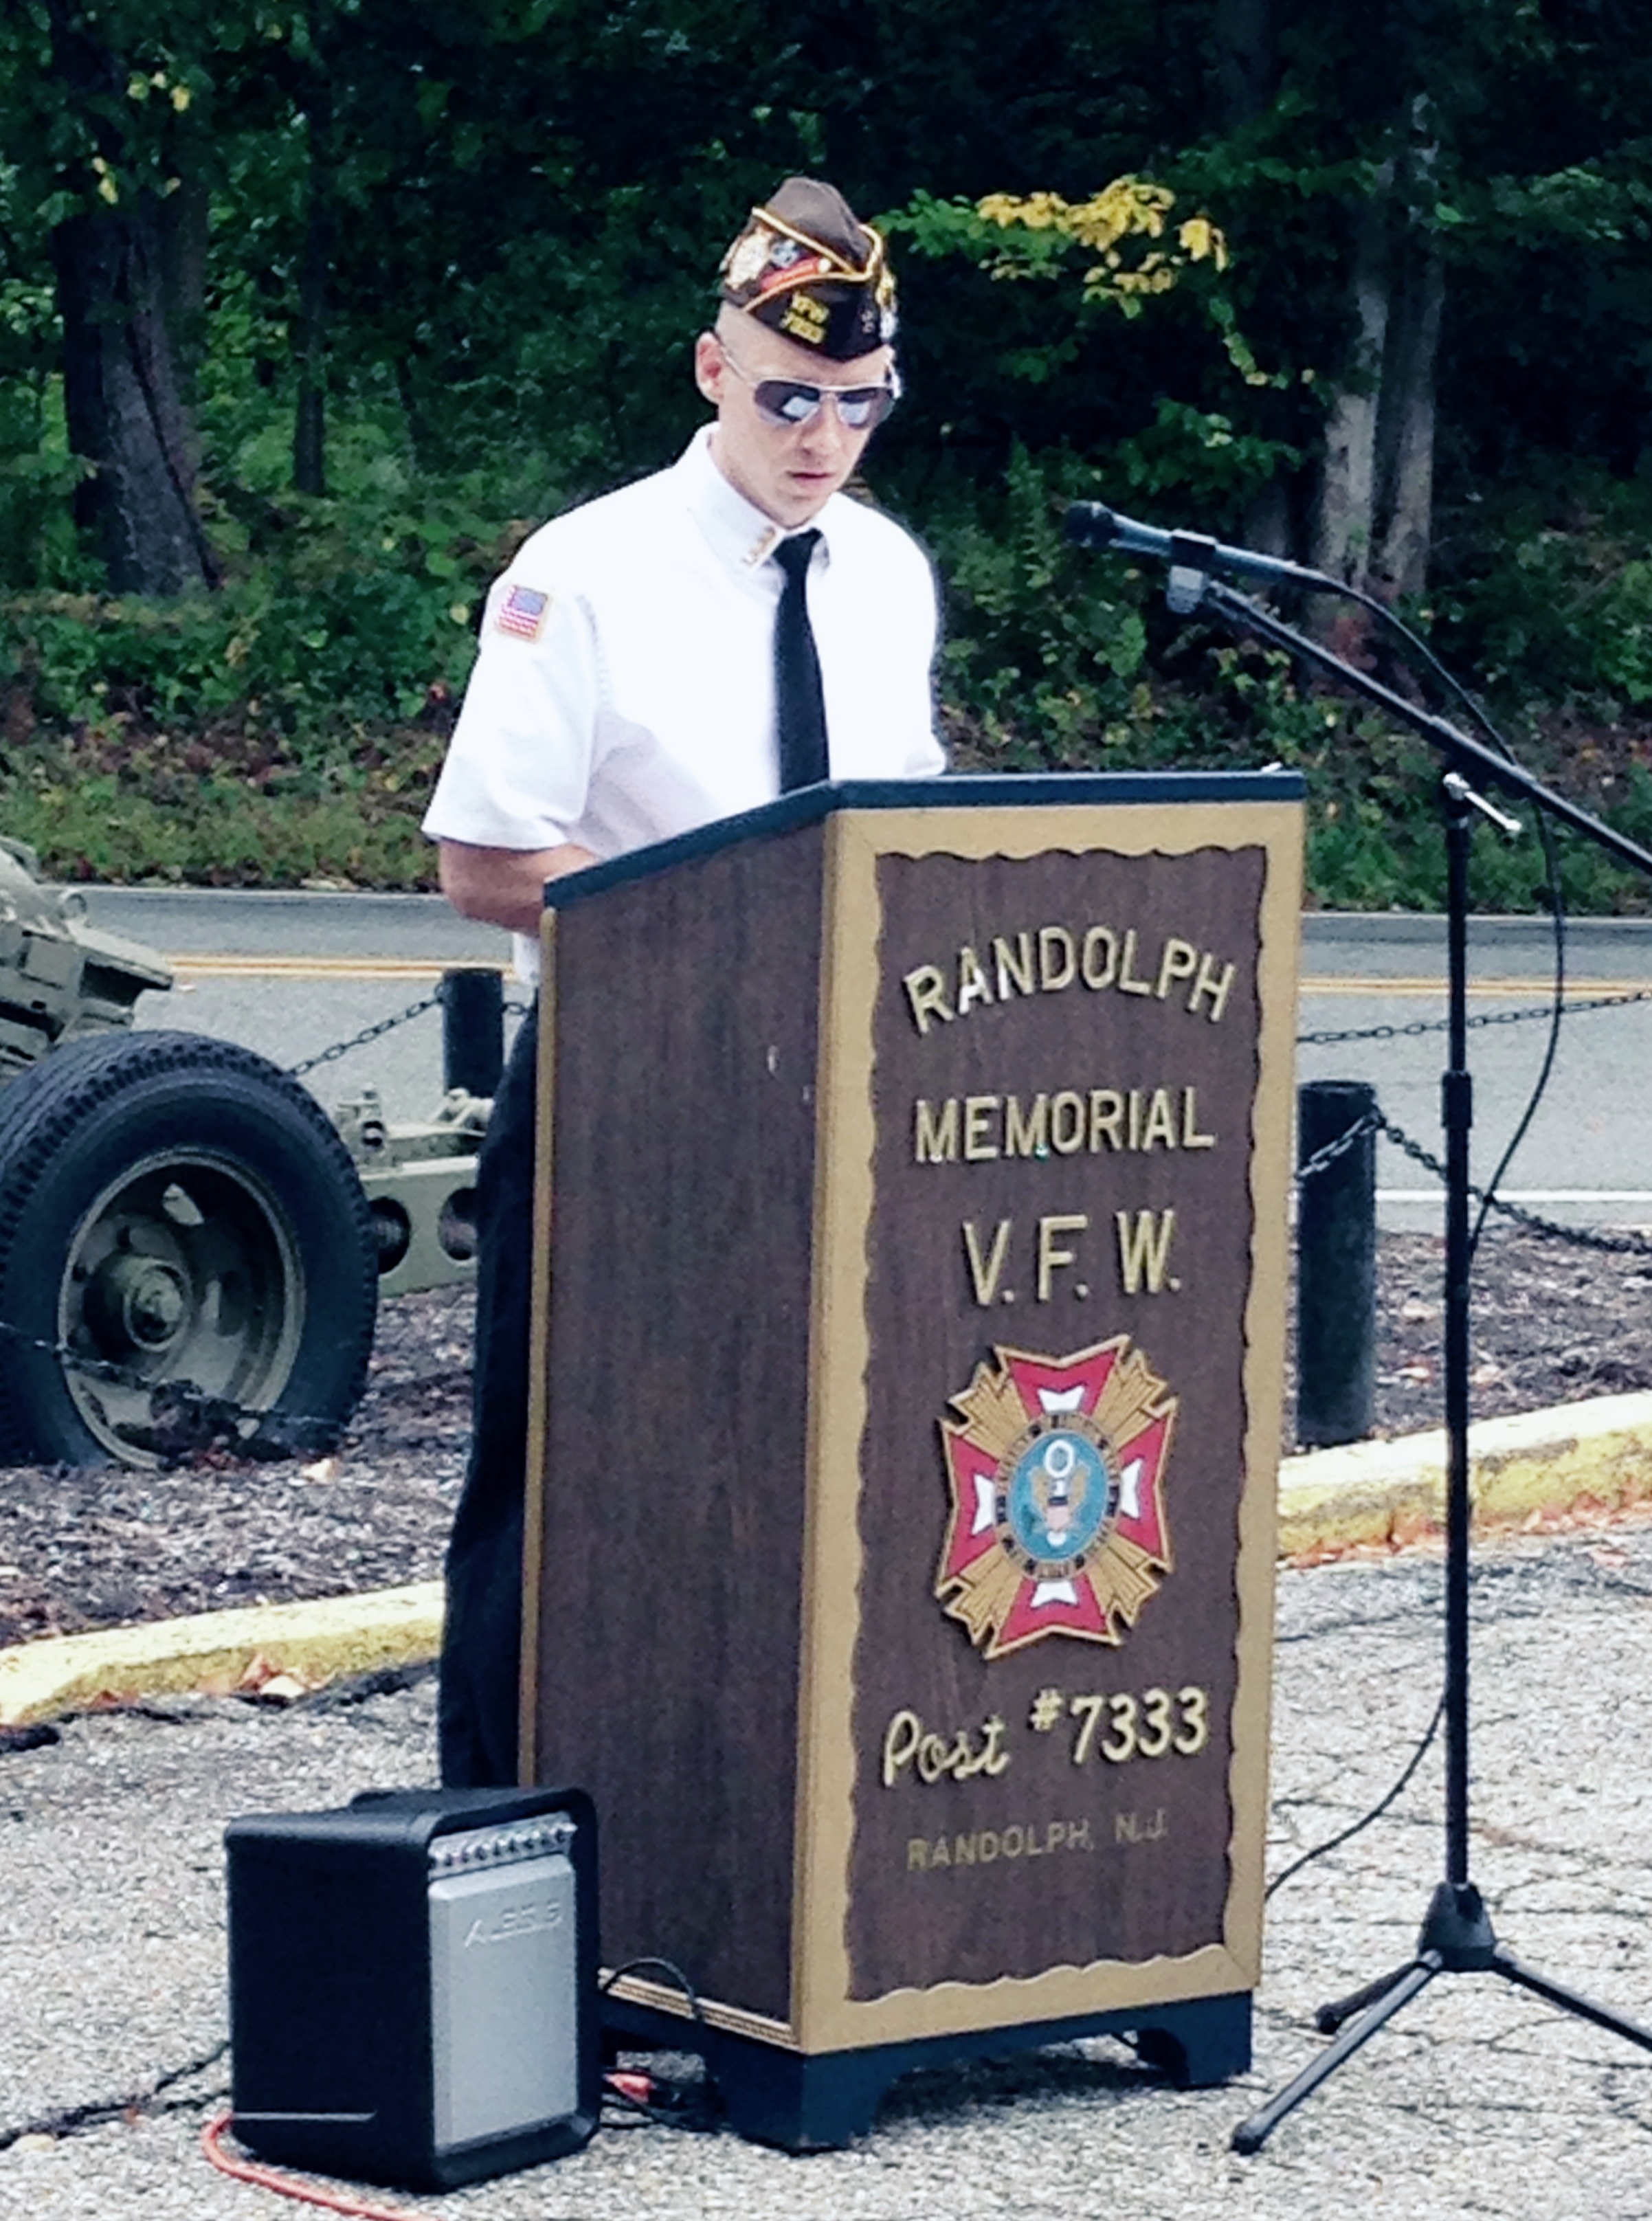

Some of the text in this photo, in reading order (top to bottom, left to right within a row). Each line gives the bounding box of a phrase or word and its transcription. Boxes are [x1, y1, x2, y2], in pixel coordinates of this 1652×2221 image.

[903, 926, 1235, 1033] RANDOLPH
[916, 1086, 1216, 1163] MEMORIAL
[963, 1209, 1181, 1305] V. F. W.
[884, 1710, 1011, 1787] Post
